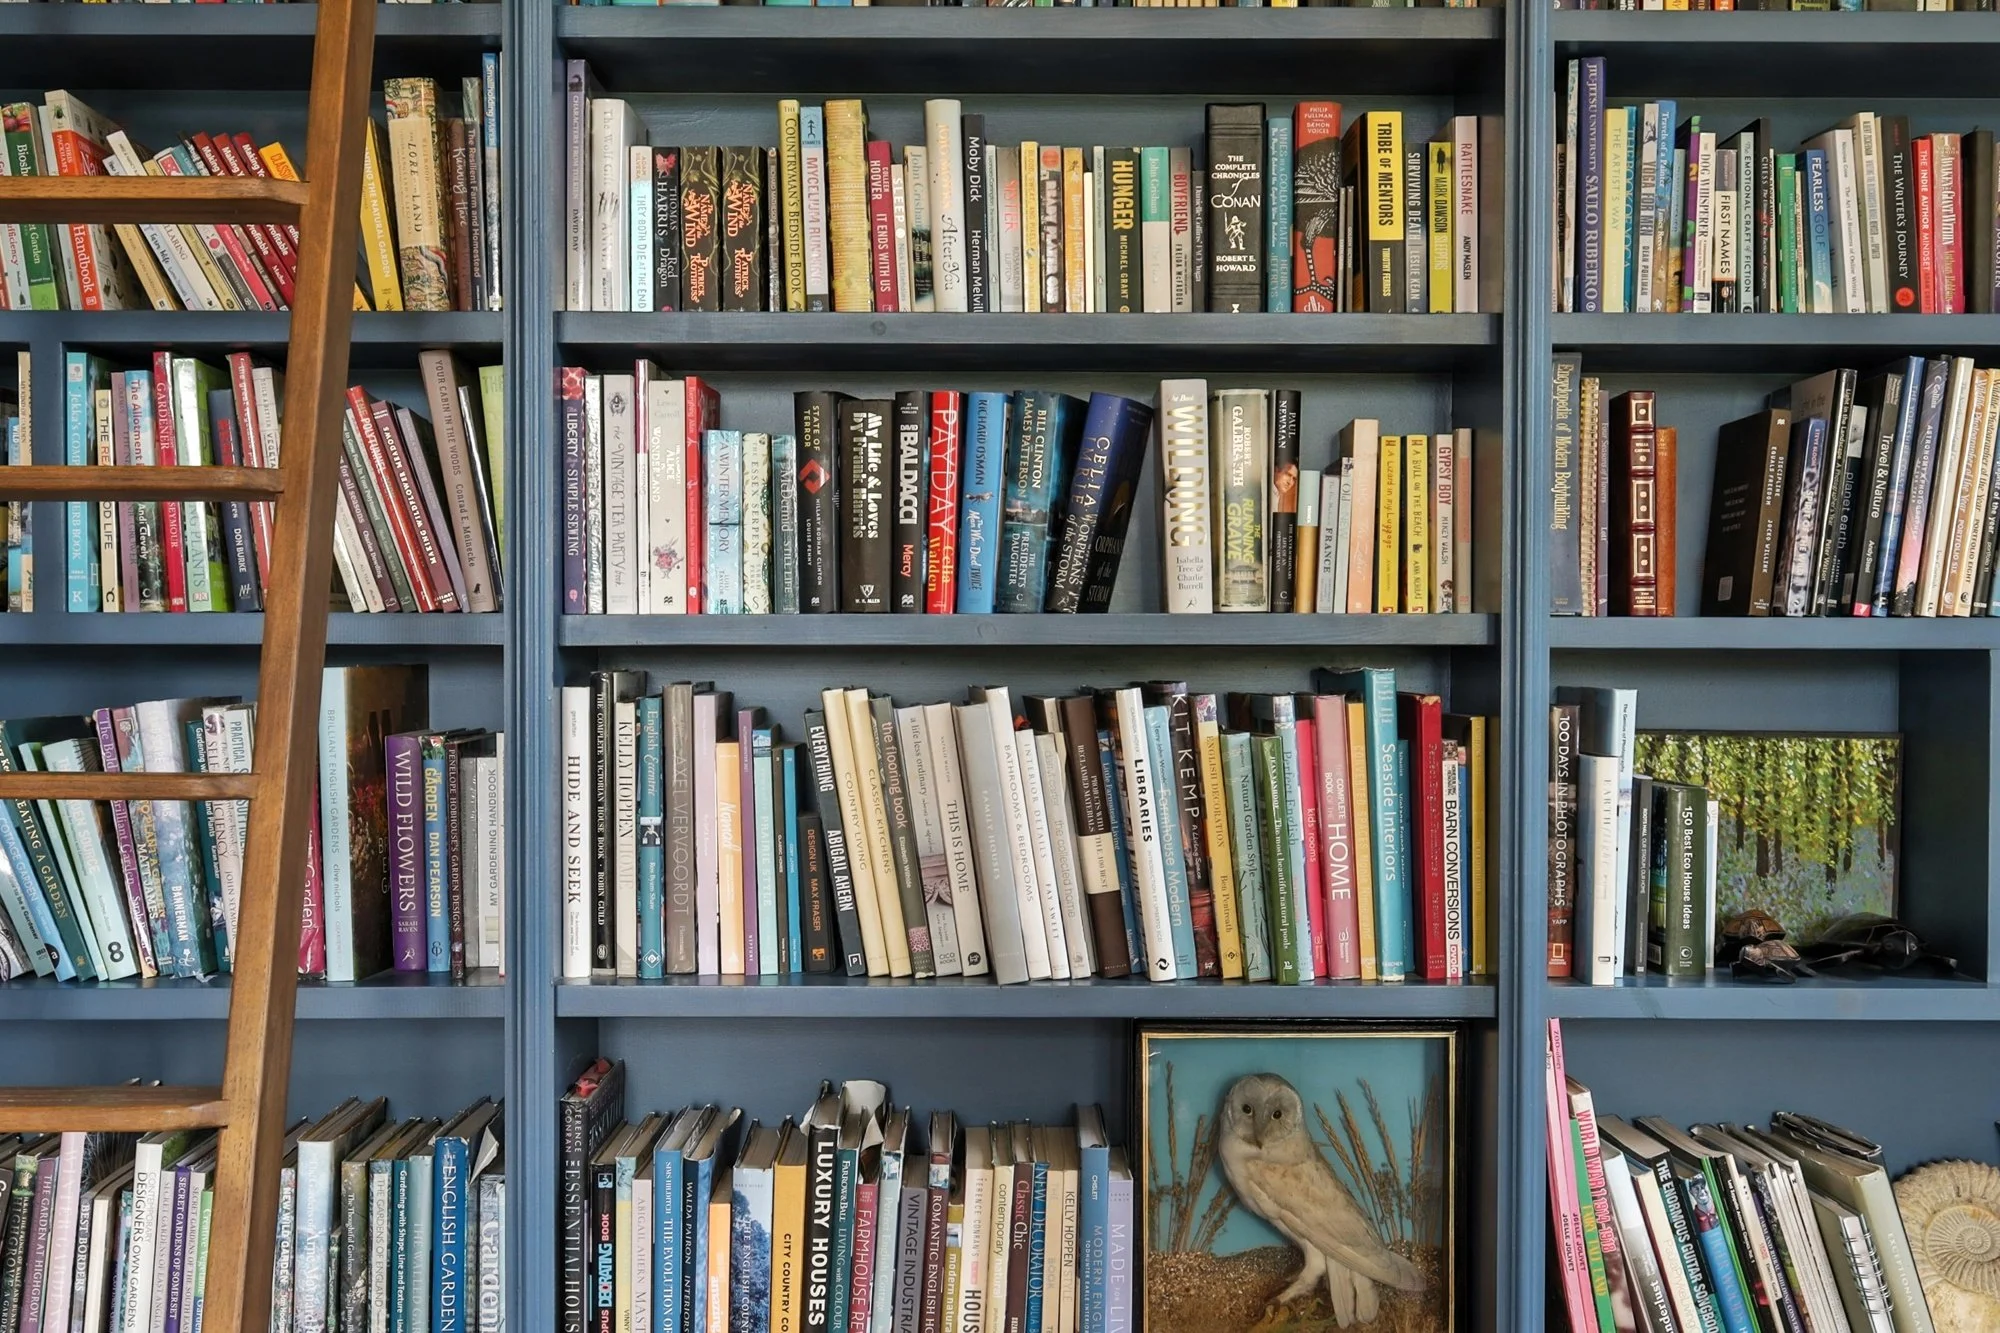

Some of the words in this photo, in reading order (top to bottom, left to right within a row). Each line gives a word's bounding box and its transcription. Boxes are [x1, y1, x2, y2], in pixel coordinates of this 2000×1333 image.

[785, 119, 798, 207] COUNTRYMAN'S
[968, 136, 982, 174] Moby
[1377, 122, 1392, 154] TRIBE
[1894, 152, 1902, 174] THE
[469, 147, 478, 184] Resilient
[805, 157, 820, 224] MYCELIUM
[870, 160, 882, 200] HOOVER
[970, 175, 983, 203] Dick
[1211, 172, 1260, 180] CHRONICLES
[1215, 163, 1256, 171] COMPLETE
[1408, 152, 1420, 206] SURVIVING
[1459, 143, 1472, 215] RATTLESNAKE
[1812, 157, 1824, 211] FEARLESS
[657, 181, 668, 237] HARRIS
[893, 177, 904, 224] SLEEP
[1112, 160, 1133, 230] HUNGER
[1211, 193, 1261, 209] CONAN
[1378, 171, 1393, 227] MENTORS
[1434, 197, 1447, 233] DAWSON
[1586, 175, 1598, 225] SAULO
[1698, 177, 1710, 238] WHISPERER
[1720, 194, 1731, 223] FIRST
[1895, 176, 1905, 227] WRITER'S
[1921, 194, 1929, 229] AUTHOR
[789, 211, 800, 257] BEDSIDE
[1408, 208, 1420, 239] DEATH
[1640, 211, 1654, 236] MEN
[1814, 214, 1826, 248] GOLF
[972, 229, 983, 271] Herman
[1120, 235, 1128, 271] MICHAEL
[1216, 264, 1257, 272] HOWARD
[1585, 229, 1599, 300] RIBEIRO
[1720, 228, 1731, 274] NAMES
[1897, 229, 1909, 279] JOURNEY
[1922, 232, 1931, 270] MINDSET
[791, 261, 802, 294] BOOK
[1121, 273, 1129, 299] GRANT
[157, 382, 170, 450] GARDENER
[1024, 398, 1035, 433] JAMES
[1931, 382, 1942, 409] Collins
[100, 417, 110, 441] THE
[132, 403, 143, 463] Allotment
[566, 412, 579, 459] LIBERTY
[1037, 409, 1047, 434] BILL
[1227, 405, 1243, 487] GALBRAITH
[1279, 400, 1287, 449] NEWMAN
[868, 442, 882, 472] Life
[931, 410, 957, 535] PAYDAY
[1018, 434, 1032, 498] PATTERSON
[1032, 436, 1046, 490] CLINTON
[1085, 437, 1110, 507] CELIA
[1439, 446, 1452, 482] GYPSY
[1880, 433, 1894, 465] Travel
[566, 469, 579, 507] SIMPLE
[900, 432, 918, 525] BALDACCI
[1167, 404, 1204, 546] WILDING
[1439, 483, 1452, 506] BOY
[1870, 480, 1886, 520] Nature
[867, 492, 882, 539] Loves
[1551, 471, 1572, 530] Bodybuilding
[104, 521, 113, 551] LIFE
[567, 509, 580, 558] SEWING
[1228, 503, 1241, 561] GRAVE
[1242, 498, 1254, 564] RUNNING
[1324, 527, 1332, 574] FRANCE
[902, 544, 914, 578] Mercy
[928, 536, 941, 592] Walden
[1008, 533, 1019, 586] DAUGHTER
[1055, 543, 1072, 590] STORM
[643, 711, 658, 751] English
[1172, 693, 1191, 739] KIT
[1558, 716, 1571, 742] 100
[619, 721, 633, 769] KELLY
[810, 724, 834, 792] EVERYTHING
[885, 744, 902, 795] flooring
[1557, 744, 1570, 778] DAYS
[394, 750, 412, 810] WILD
[424, 768, 438, 822] GARDEN
[566, 755, 580, 803] HIDE
[1178, 749, 1200, 819] KEMP
[1382, 743, 1395, 808] Seaside
[619, 773, 633, 839] HOPPEN
[844, 771, 860, 829] COUNTRY
[854, 831, 866, 871] LIVING
[893, 796, 906, 828] book
[1004, 745, 1022, 820] BATHROOMS
[1018, 833, 1034, 903] BEDROOMS
[1134, 759, 1152, 843] LIBRARIES
[1307, 807, 1316, 830] kids
[1445, 800, 1458, 841] BARN
[429, 832, 440, 855] DAN
[567, 810, 580, 849] AND
[827, 830, 845, 875] ABIGAIL
[876, 816, 891, 874] KITCHENS
[947, 800, 961, 833] THIS
[954, 851, 970, 893] HOME
[1383, 811, 1396, 881] Interiors
[1553, 797, 1569, 908] PHOTOGRAPHS
[396, 814, 417, 914] FLOWERS
[567, 855, 581, 905] SEEK
[672, 796, 689, 916] VERVOORDT
[1328, 823, 1350, 900] HOME
[41, 865, 68, 920] GARDEN
[429, 858, 442, 918] PEARSON
[834, 877, 854, 913] AHERN
[1168, 870, 1182, 928] Modern
[1446, 842, 1461, 941] CONVERSIONS
[1683, 867, 1692, 899] House
[170, 885, 189, 941] BANNERMAN
[811, 897, 821, 931] FRASER
[1682, 902, 1692, 931] Ideas
[1576, 1109, 1600, 1157] WORLD
[132, 1172, 148, 1242] DESIGNERS
[441, 1164, 457, 1244] ENGLISH
[814, 1141, 834, 1231] LUXURY
[1015, 1180, 1028, 1220] Classic
[80, 1203, 92, 1232] BEST
[564, 1170, 580, 1280] ESSENTIAL
[601, 1213, 610, 1241] BOOK
[905, 1194, 920, 1257] VINTAGE
[930, 1195, 943, 1260] ROMANTIC
[995, 1183, 1007, 1256] contemporary
[1014, 1221, 1028, 1250] Chic
[1663, 1185, 1690, 1242] ENORMOUS
[75, 1236, 88, 1292] BORDERS
[131, 1244, 142, 1268] OWN
[784, 1234, 792, 1258] CITY
[852, 1209, 872, 1306] FARMHOUSE
[1064, 1224, 1074, 1267] HOPPEN
[1093, 1225, 1103, 1286] MODERN
[1110, 1224, 1125, 1283] MADE
[29, 1262, 43, 1323] HIGHGROVE
[169, 1270, 181, 1324] SOMERSET
[598, 1243, 613, 1308] DECORATING
[782, 1262, 792, 1314] COUNTRY
[808, 1238, 829, 1327] HOUSES
[926, 1263, 938, 1316] ENGLISH
[948, 1253, 956, 1294] modern
[127, 1270, 141, 1328] GARDENS
